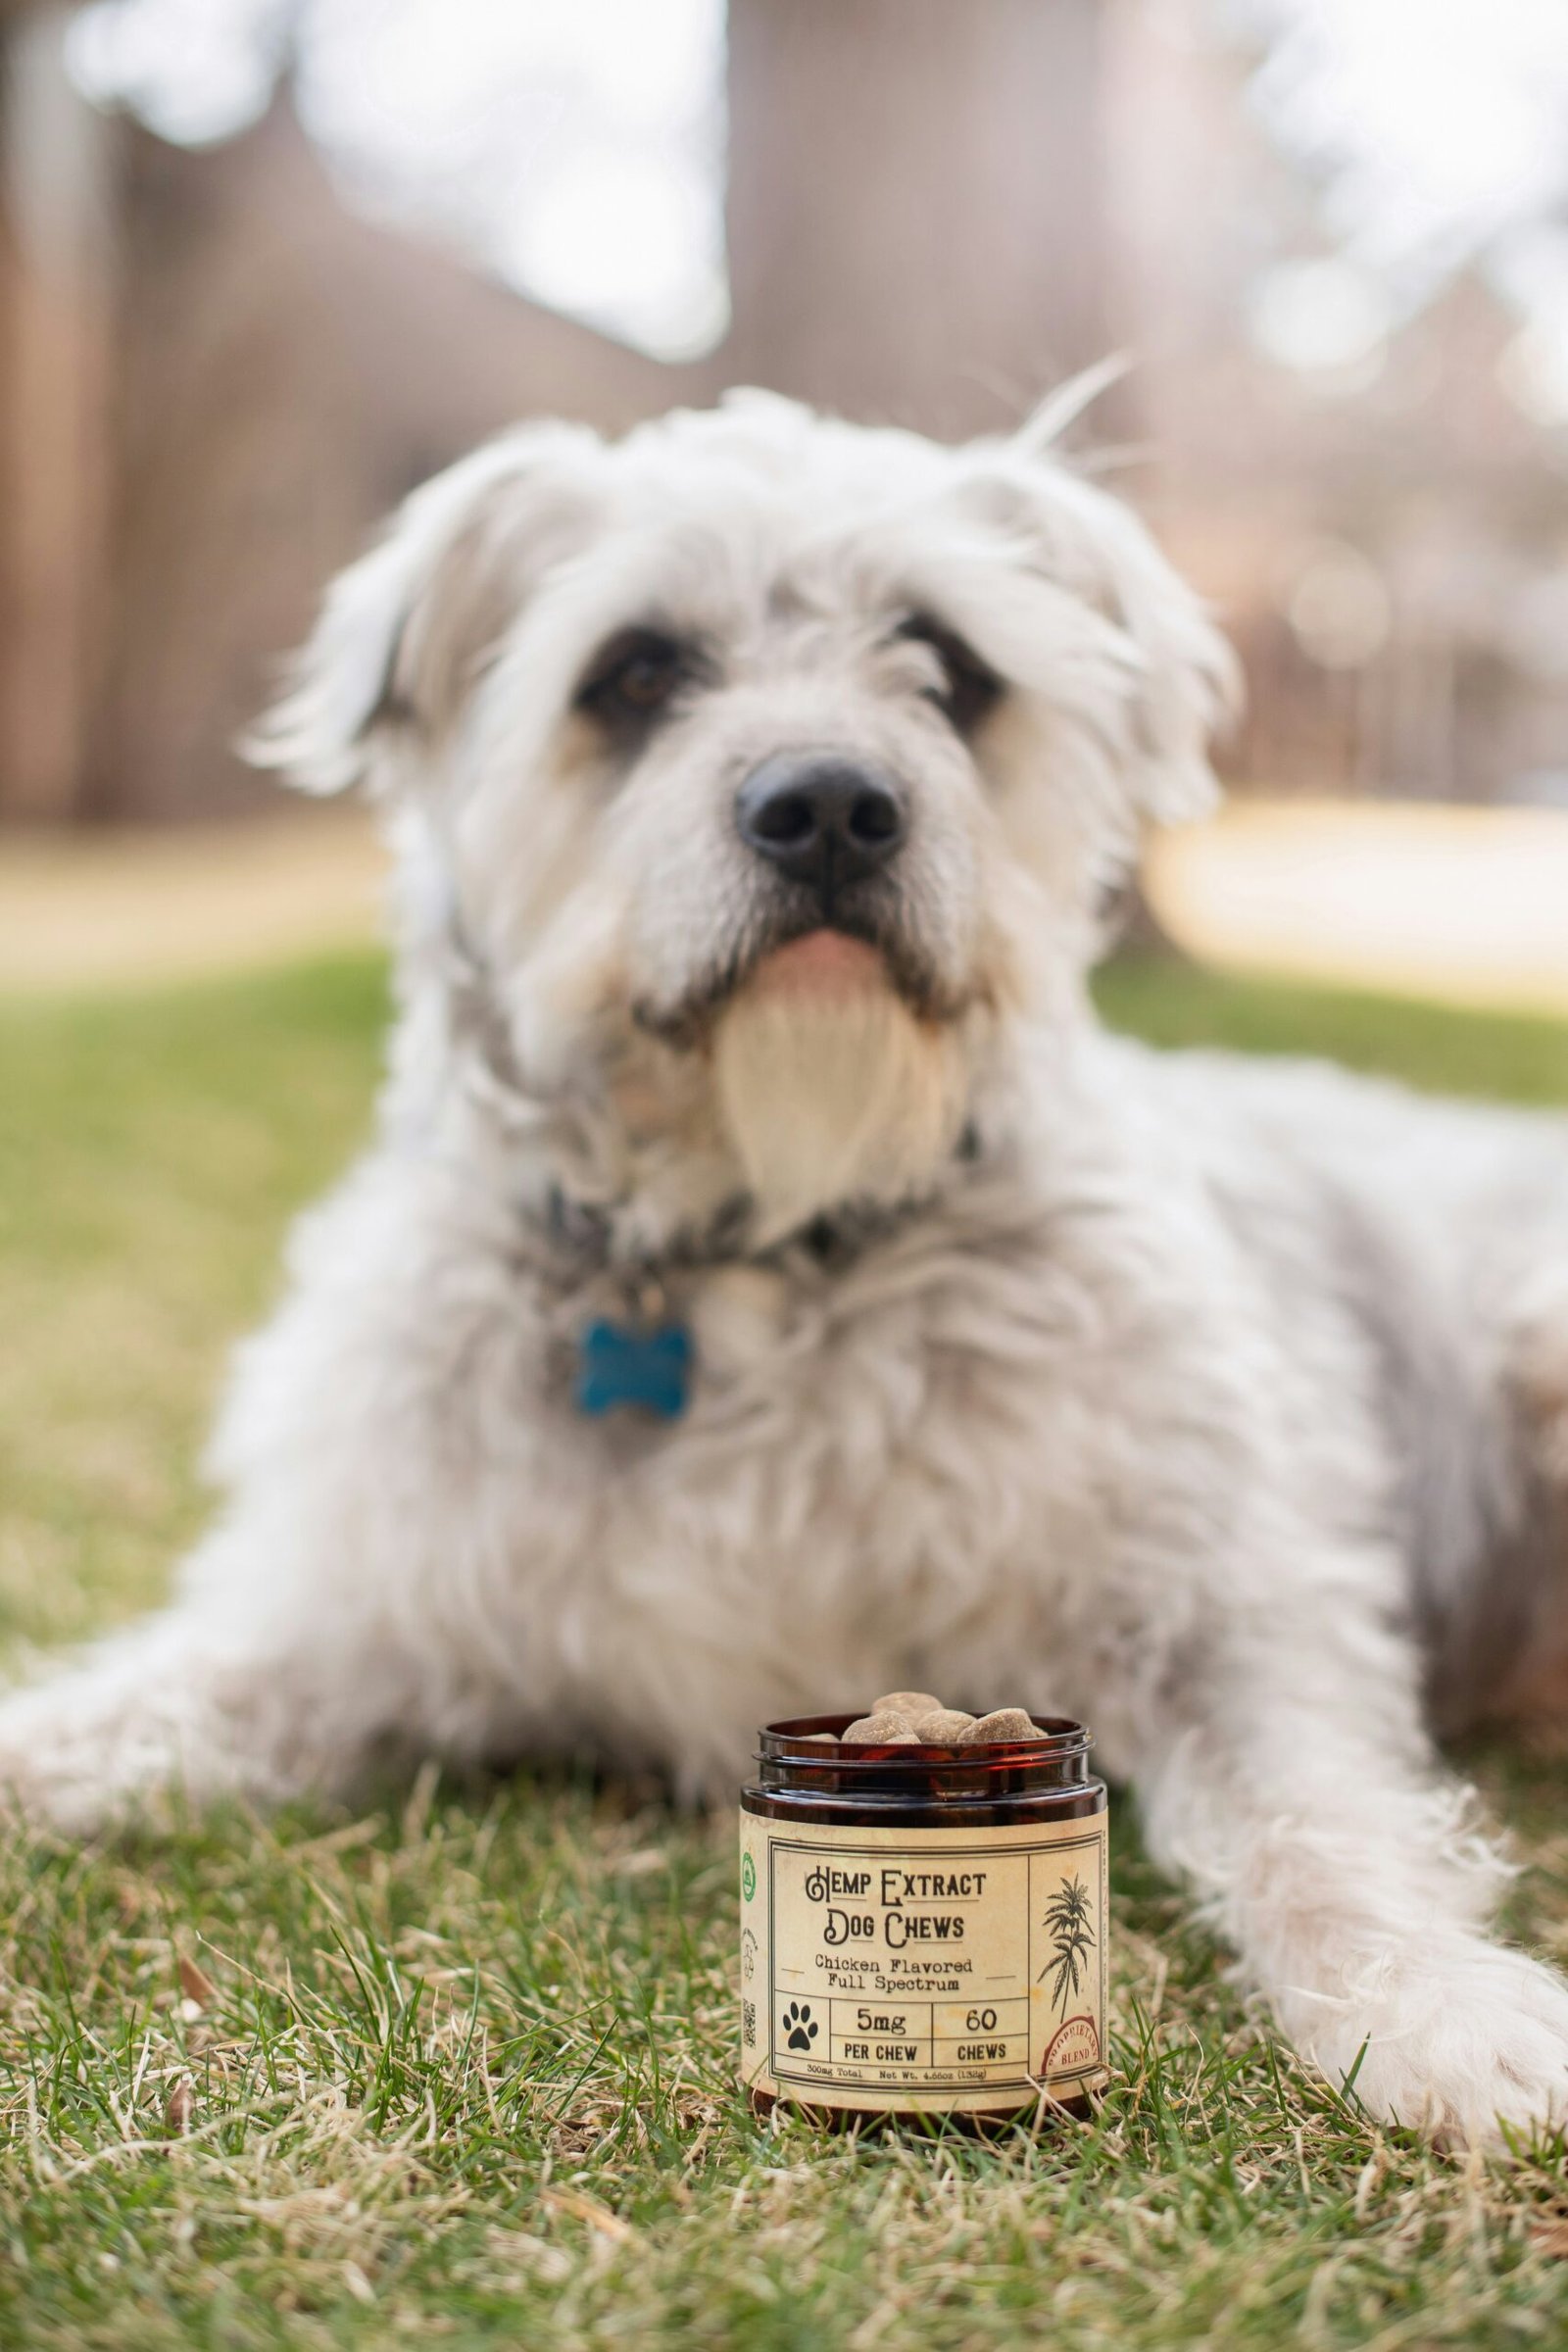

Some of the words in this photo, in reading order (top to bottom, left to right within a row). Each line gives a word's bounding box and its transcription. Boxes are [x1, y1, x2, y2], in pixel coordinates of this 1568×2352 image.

[814, 1953, 880, 1973] Chicken
[890, 1959, 973, 1974] Flavored
[827, 1973, 866, 1989] Full
[875, 1976, 960, 1993] Spectrum
[857, 2008, 906, 2035] 5mg
[965, 2008, 998, 2032] 60
[844, 2042, 869, 2060] PER
[875, 2044, 917, 2062] CHEW
[957, 2043, 1006, 2061] CHEWS
[1061, 2047, 1090, 2066] BLEND
[807, 2064, 833, 2077] 300mg
[836, 2067, 862, 2079] Total
[879, 2070, 897, 2080] Net
[902, 2071, 918, 2080] Wt.
